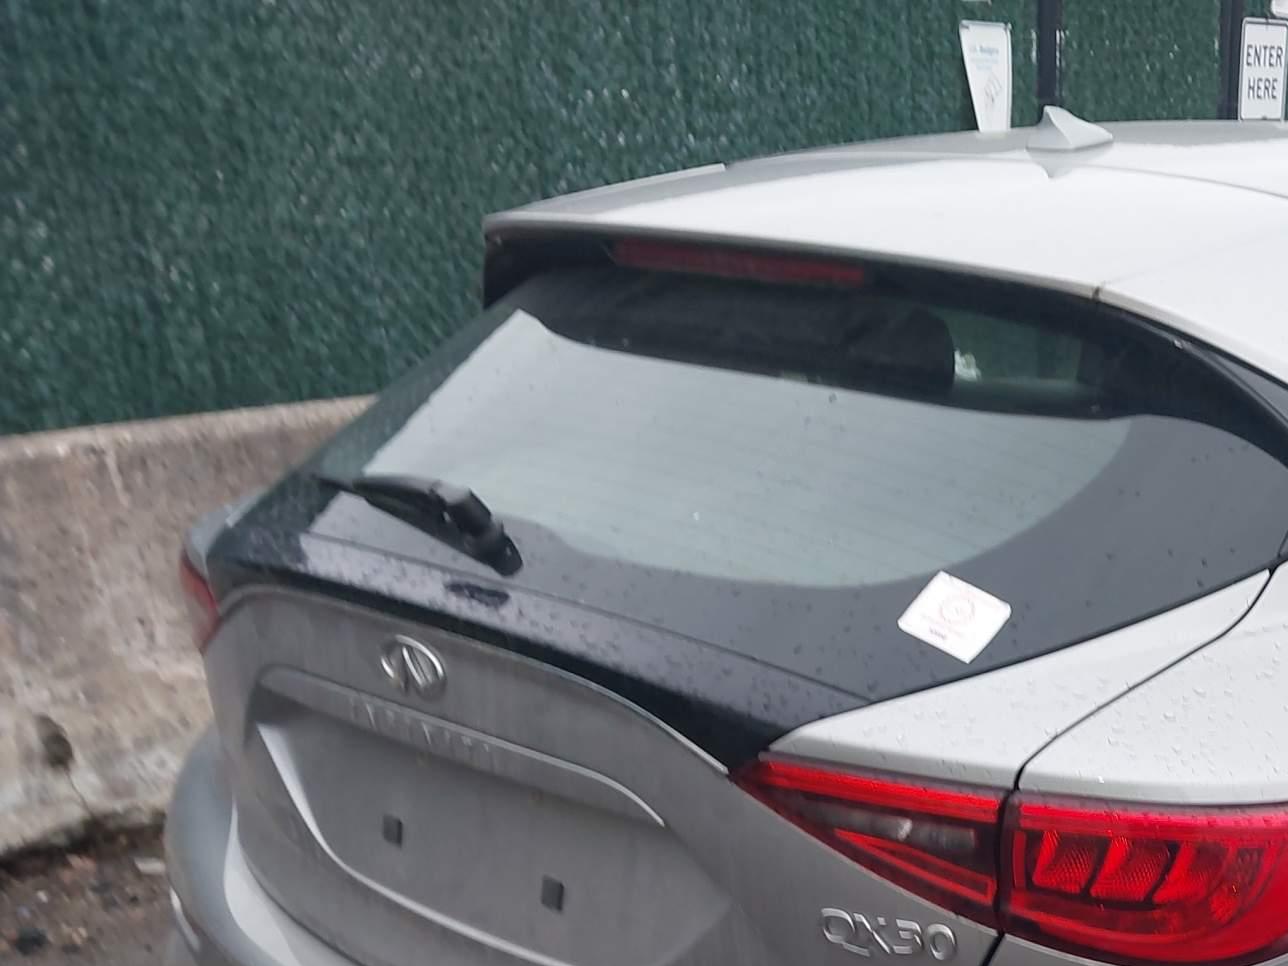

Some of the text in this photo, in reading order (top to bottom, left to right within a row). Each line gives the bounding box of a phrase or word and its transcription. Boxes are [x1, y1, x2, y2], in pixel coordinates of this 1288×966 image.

[1246, 43, 1284, 68] ENTER
[1247, 76, 1279, 101] HERE
[819, 907, 958, 962] QX30
